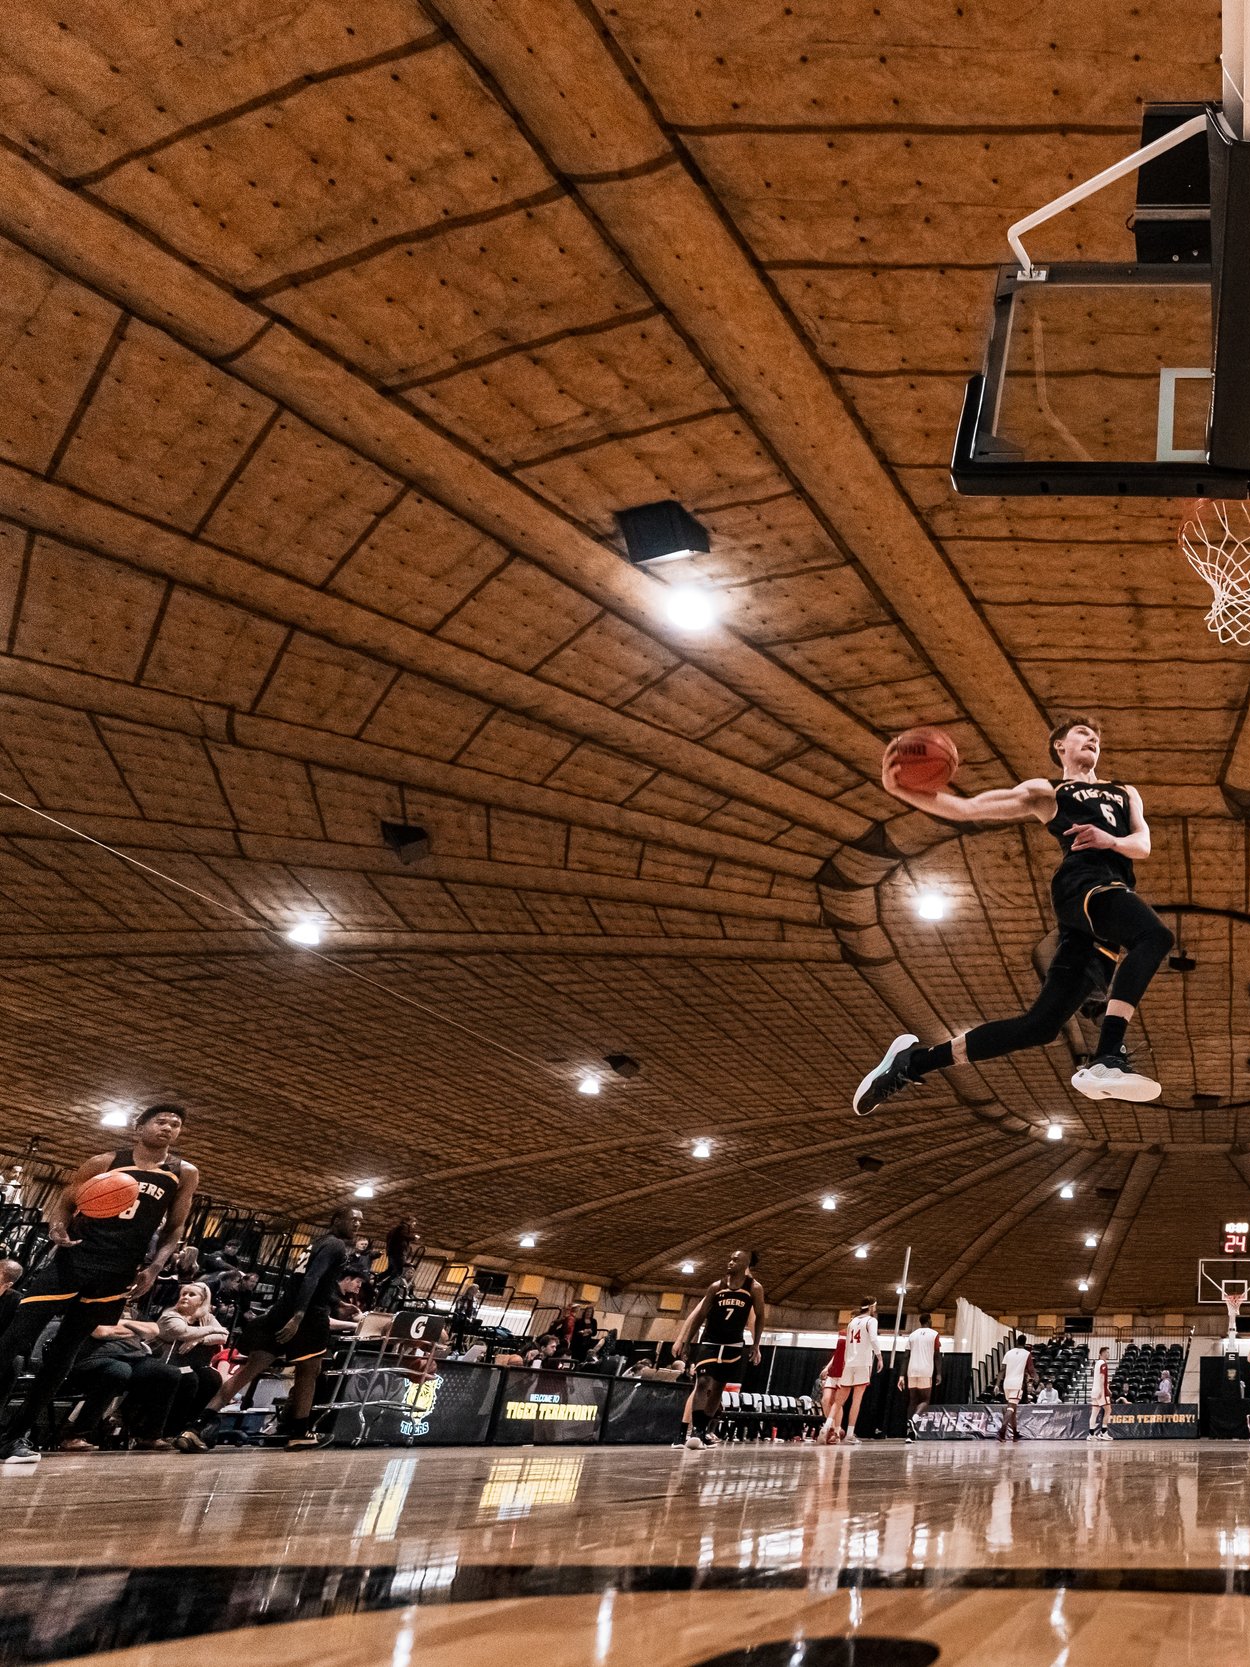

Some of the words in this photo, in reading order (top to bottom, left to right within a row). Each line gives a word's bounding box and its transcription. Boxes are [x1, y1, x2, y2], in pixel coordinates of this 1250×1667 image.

[139, 1181, 165, 1201] ERS
[1224, 1234, 1247, 1253] 24
[718, 1298, 746, 1308] TIGERS
[724, 1307, 735, 1321] 7
[410, 1315, 429, 1340] G
[850, 1328, 862, 1344] 14
[506, 1401, 539, 1420] TIGER
[538, 1403, 599, 1422] TERRITORY!
[1136, 1413, 1196, 1424] TERRITORY!
